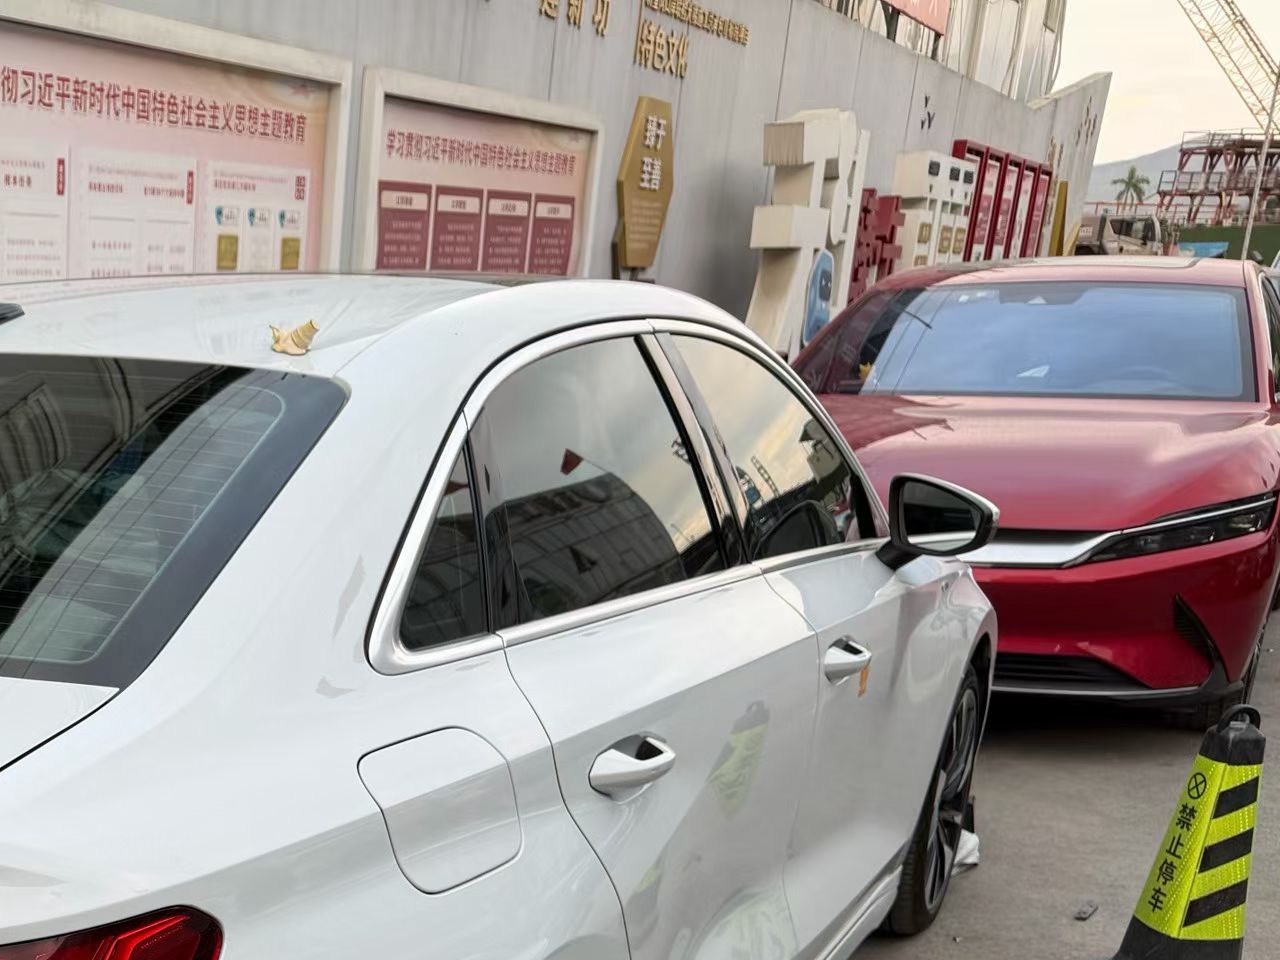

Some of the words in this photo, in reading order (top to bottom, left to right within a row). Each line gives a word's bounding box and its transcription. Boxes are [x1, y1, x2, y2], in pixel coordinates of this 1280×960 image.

[638, 17, 689, 78] 特色文化
[1147, 802, 1197, 913] 禁止停车
